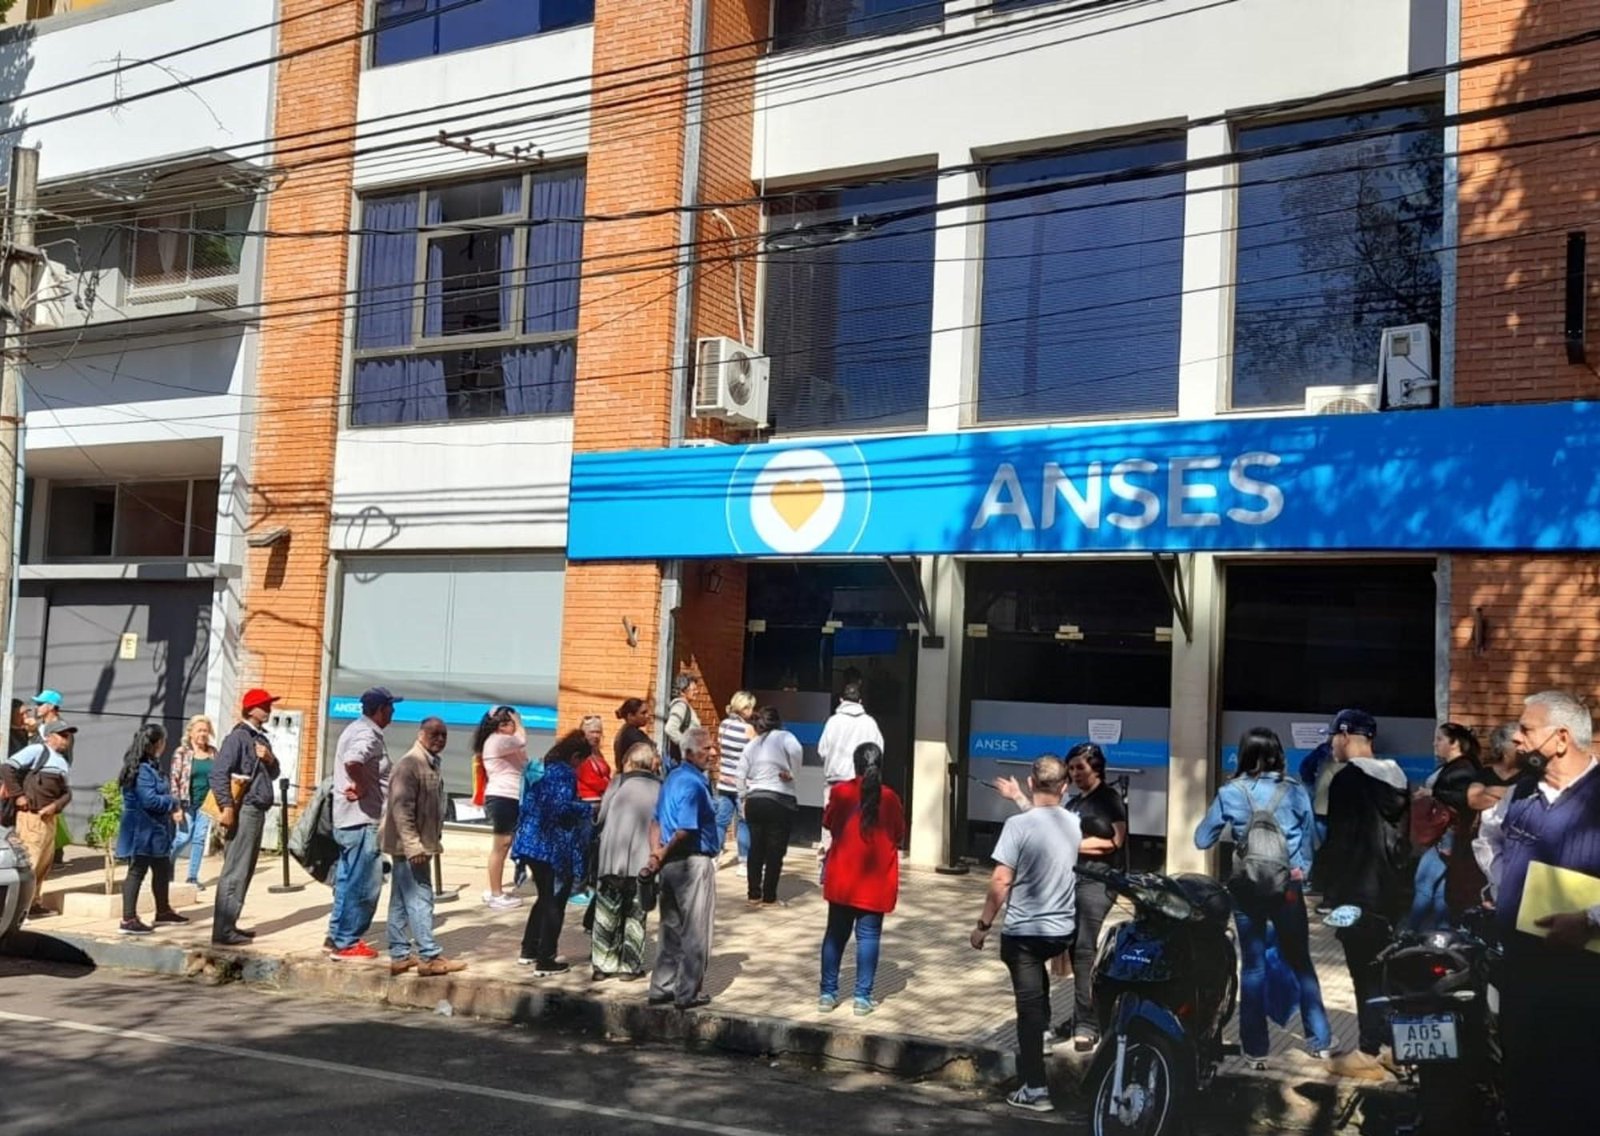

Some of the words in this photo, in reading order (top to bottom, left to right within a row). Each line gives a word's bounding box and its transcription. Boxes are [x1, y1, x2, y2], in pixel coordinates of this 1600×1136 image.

[971, 451, 1284, 530] ANSES
[975, 738, 1018, 752] ANSES
[1408, 1024, 1442, 1041] A05
